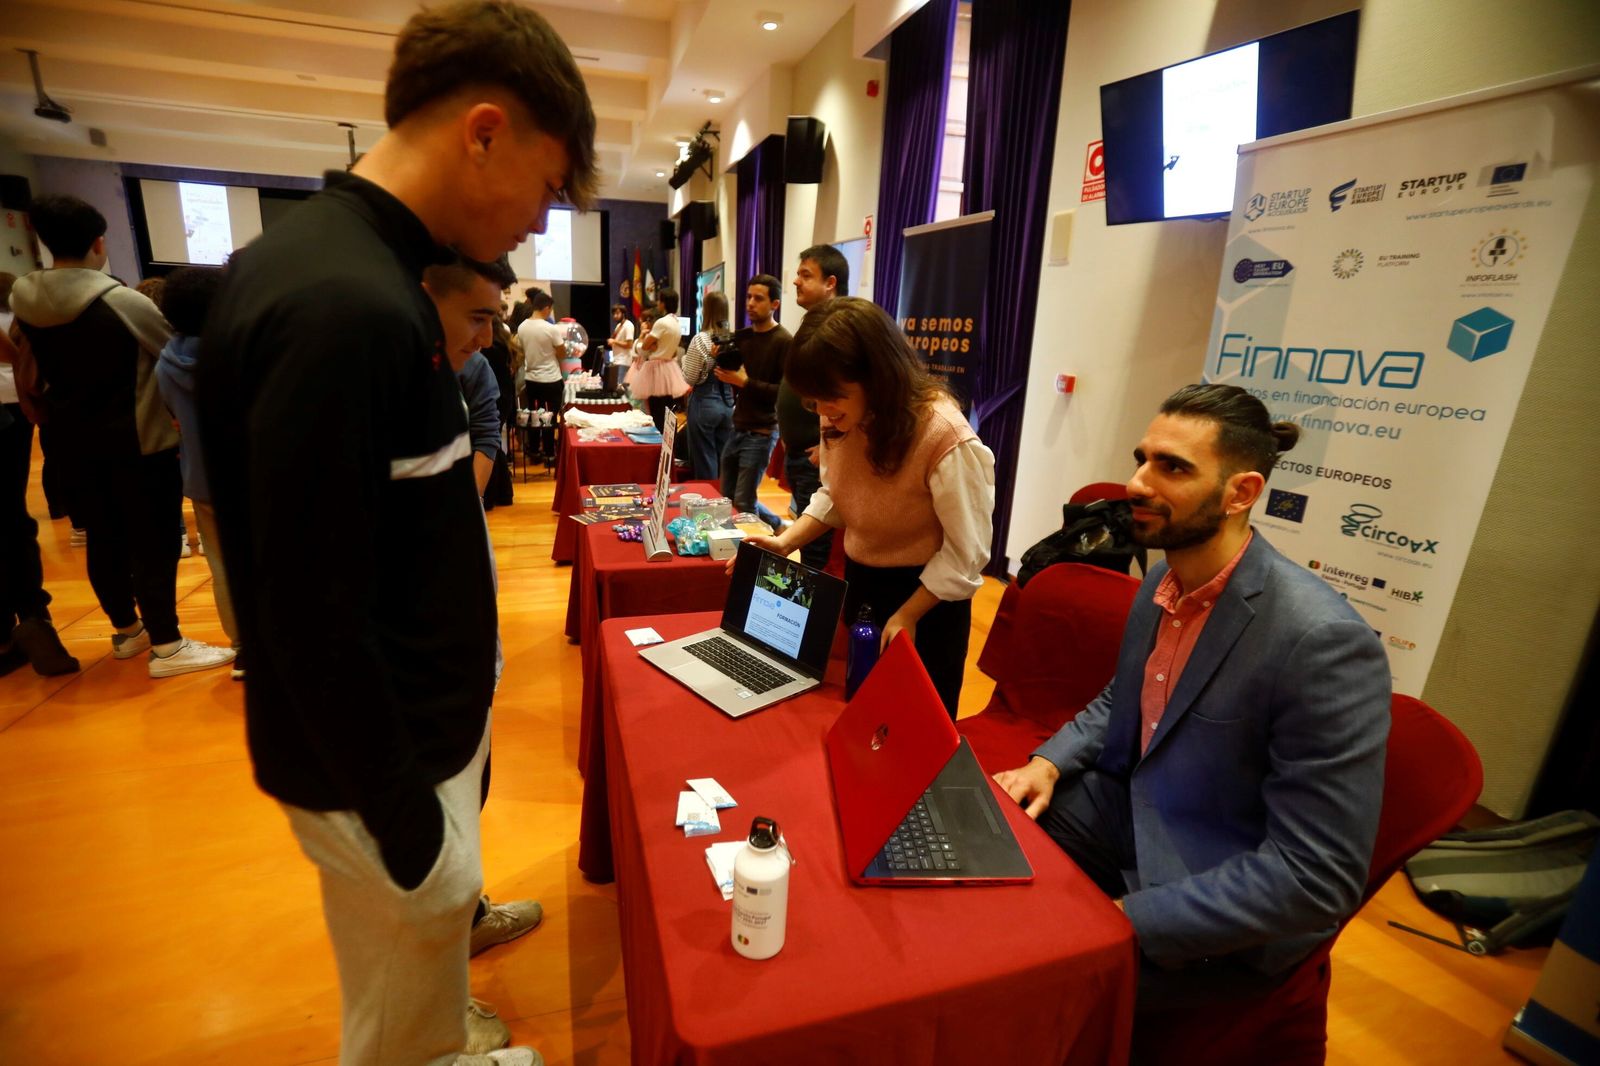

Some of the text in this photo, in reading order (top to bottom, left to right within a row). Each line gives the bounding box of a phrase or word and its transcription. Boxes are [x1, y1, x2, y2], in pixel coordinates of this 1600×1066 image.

[1354, 184, 1383, 193] STARTUP
[1399, 172, 1467, 191] STARTUP
[1270, 187, 1312, 202] STARTUP
[1352, 190, 1381, 200] EUROPE
[1398, 183, 1465, 199] EUROPE
[1268, 197, 1309, 211] EUROPE
[1272, 262, 1285, 270] EU
[1465, 273, 1518, 282] INFOFLASH
[921, 317, 973, 333] semos
[908, 336, 970, 356] uropeos
[1216, 333, 1425, 390] Finnova
[1271, 390, 1290, 402] en
[1294, 390, 1390, 413] financiación
[1394, 402, 1487, 422] europea
[1273, 460, 1393, 490] ECTOS EUROPEOS
